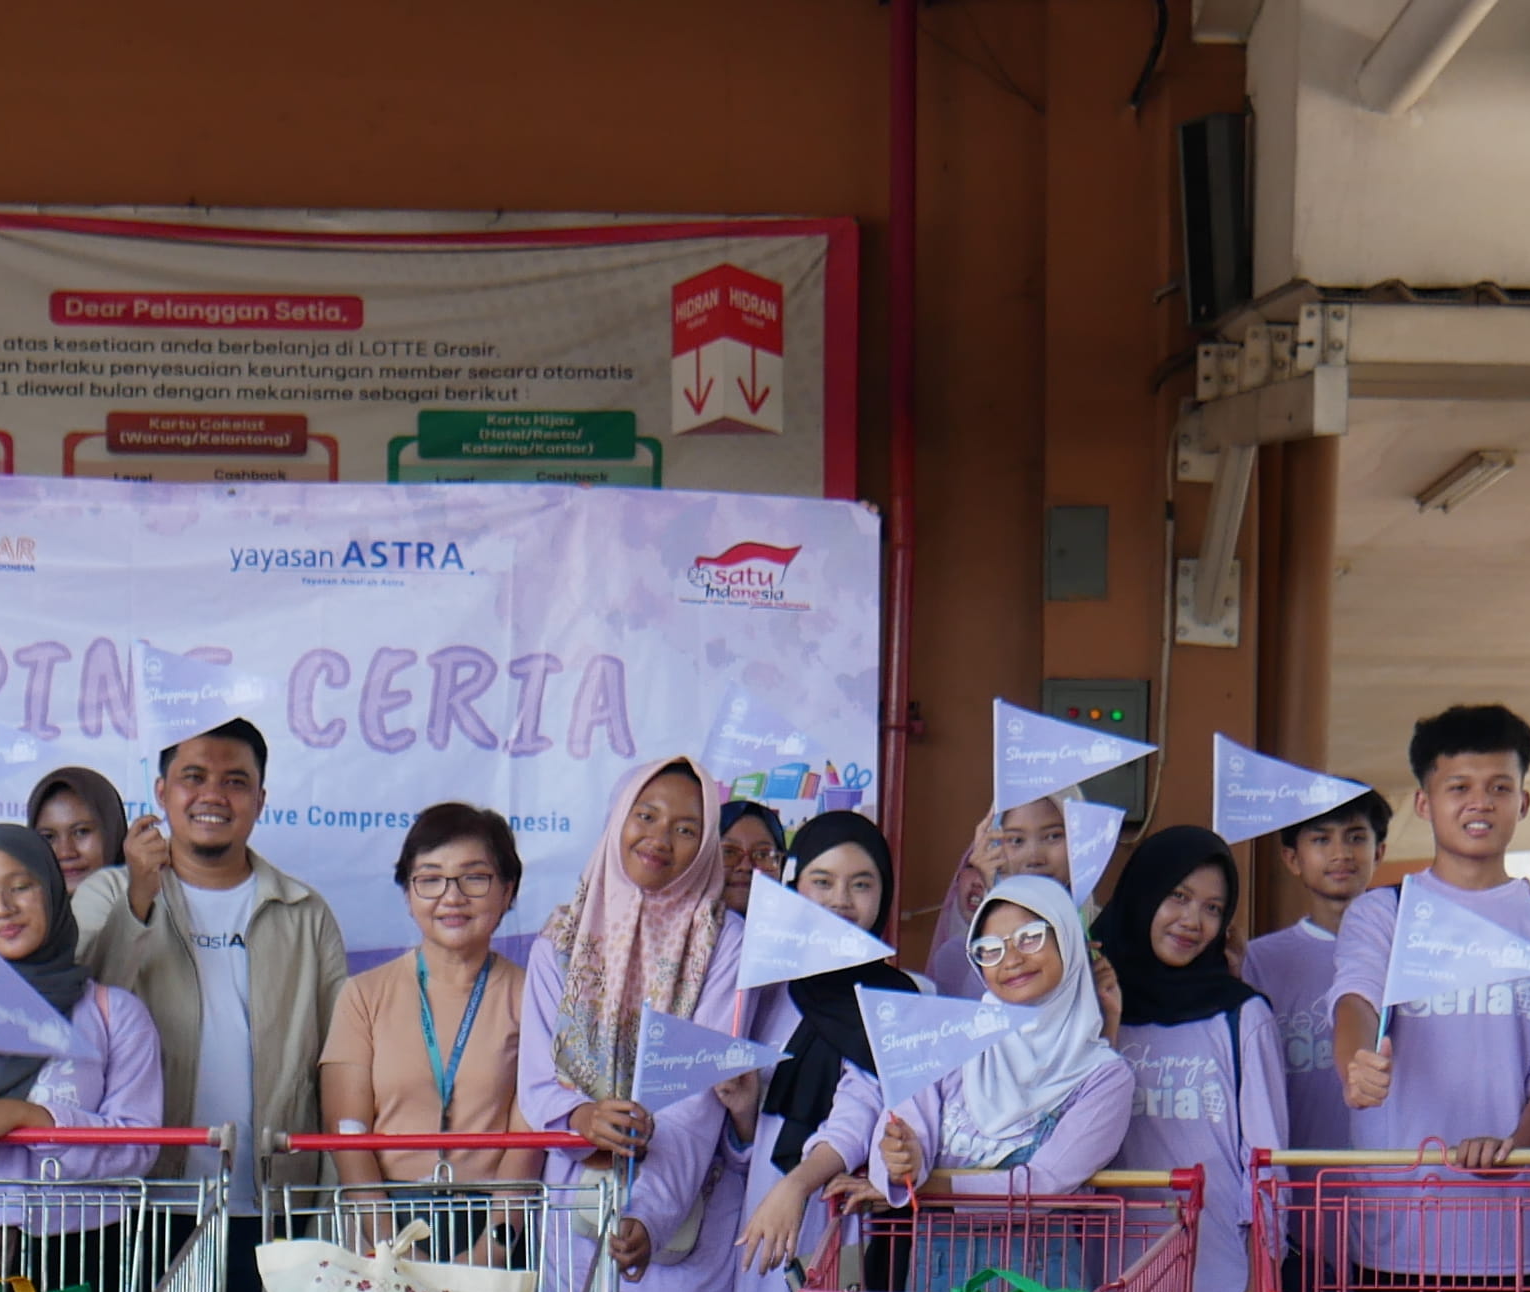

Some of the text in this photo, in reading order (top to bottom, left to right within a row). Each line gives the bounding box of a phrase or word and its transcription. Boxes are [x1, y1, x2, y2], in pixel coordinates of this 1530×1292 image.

[65, 299, 268, 325] Dear Pelanggan
[675, 287, 720, 325] HIDRAN
[729, 286, 777, 323] HIDRAN
[3, 337, 47, 352] atas
[54, 336, 155, 354] kesetiaan
[161, 337, 213, 354] anda
[219, 337, 329, 359] berbelanja
[336, 340, 354, 358] di
[360, 341, 428, 358] LOTTE
[26, 359, 104, 377] berlaku
[110, 360, 242, 380] penyesuaian
[248, 361, 374, 382] keuntungan
[379, 363, 461, 380] member
[467, 366, 538, 381] secara
[542, 363, 634, 381] otomatis
[1, 380, 9, 395] 1
[16, 380, 84, 397] diawal
[90, 381, 147, 398] bulan
[152, 383, 231, 402] dengan
[236, 384, 354, 401] mekanisme
[359, 387, 439, 404] sebagai
[444, 386, 518, 402] berikut
[149, 417, 196, 430] Kartu
[486, 414, 531, 427] Kartu
[213, 469, 288, 482] Cashback
[230, 540, 465, 573] yayasan ASTRA
[714, 566, 774, 588] satu
[704, 582, 785, 601] Indonesia
[285, 644, 637, 760] CERIA
[1006, 747, 1058, 766] Shopping
[1226, 783, 1277, 803] Shopping
[1406, 932, 1466, 960] Shopping
[880, 1021, 970, 1054] Shopping Ceria
[643, 1052, 694, 1073] Shopping
[912, 1060, 942, 1074] ASTRA
